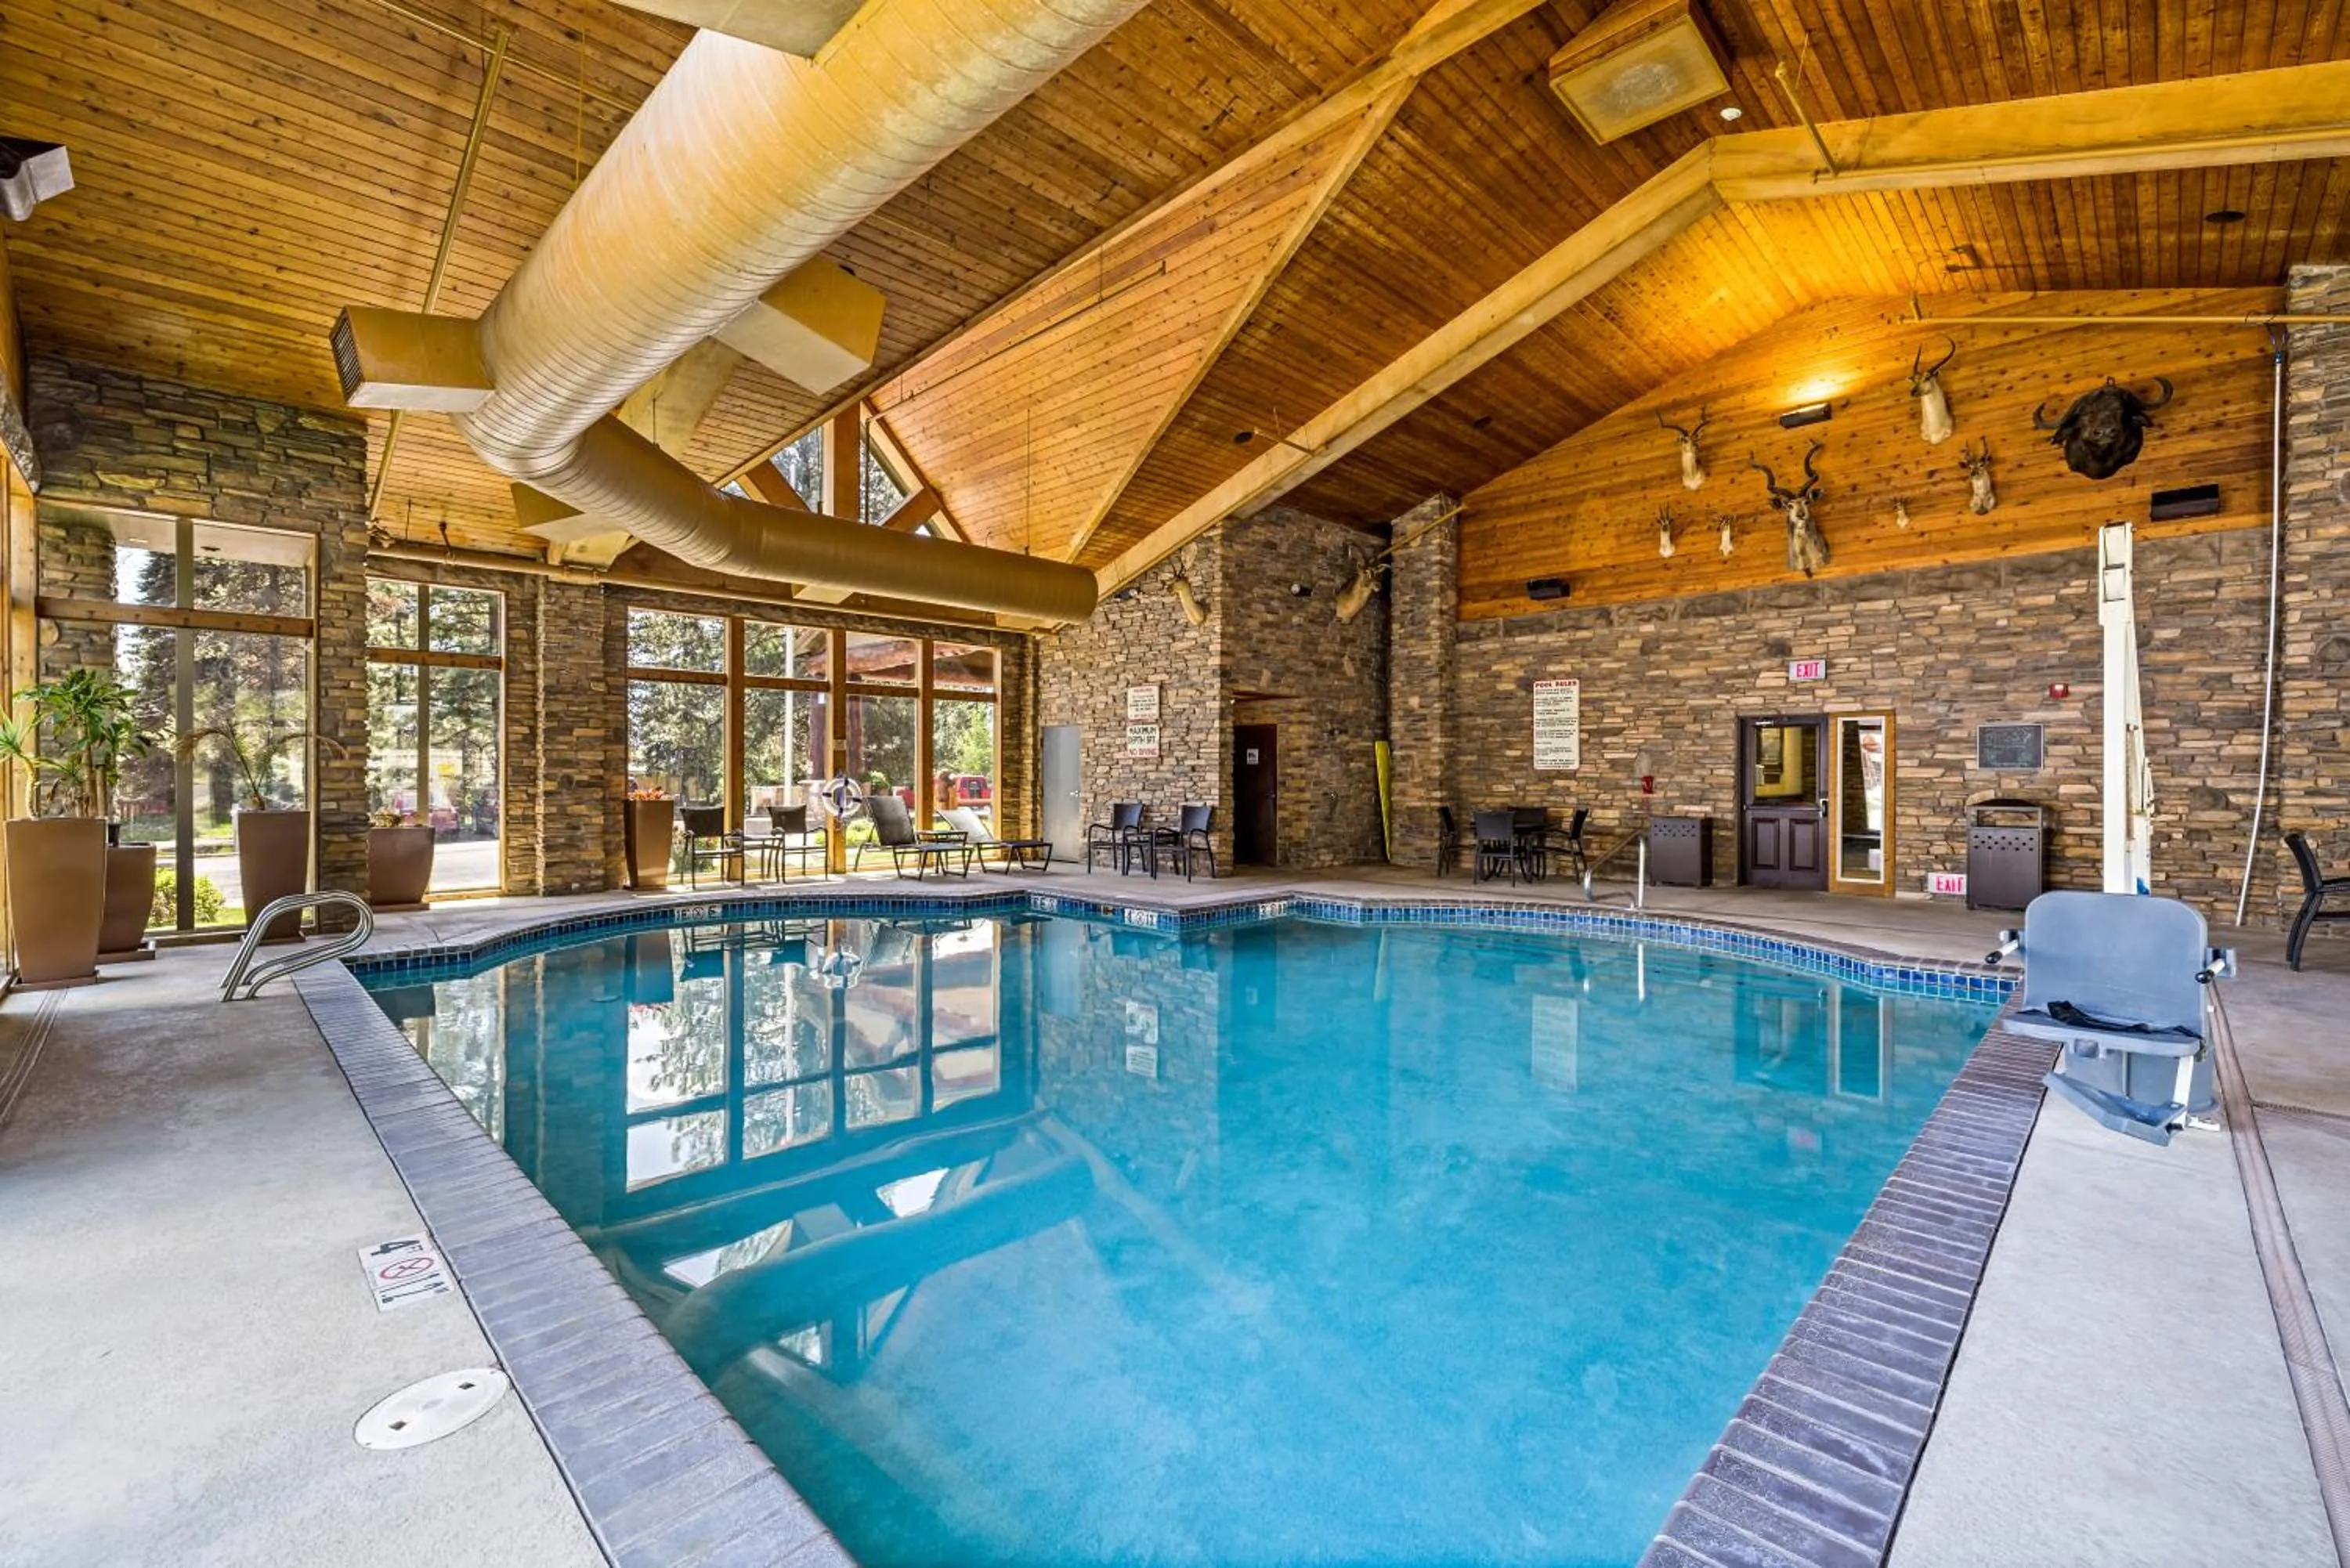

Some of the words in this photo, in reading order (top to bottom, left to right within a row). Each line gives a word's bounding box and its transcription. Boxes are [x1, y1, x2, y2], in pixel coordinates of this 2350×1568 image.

[1796, 662, 1820, 677] EXIT
[1129, 726, 1157, 735] MAXIMUM
[1128, 735, 1145, 745] DEPTH
[1936, 876, 1964, 892] EXIT
[371, 1240, 420, 1256] 4
